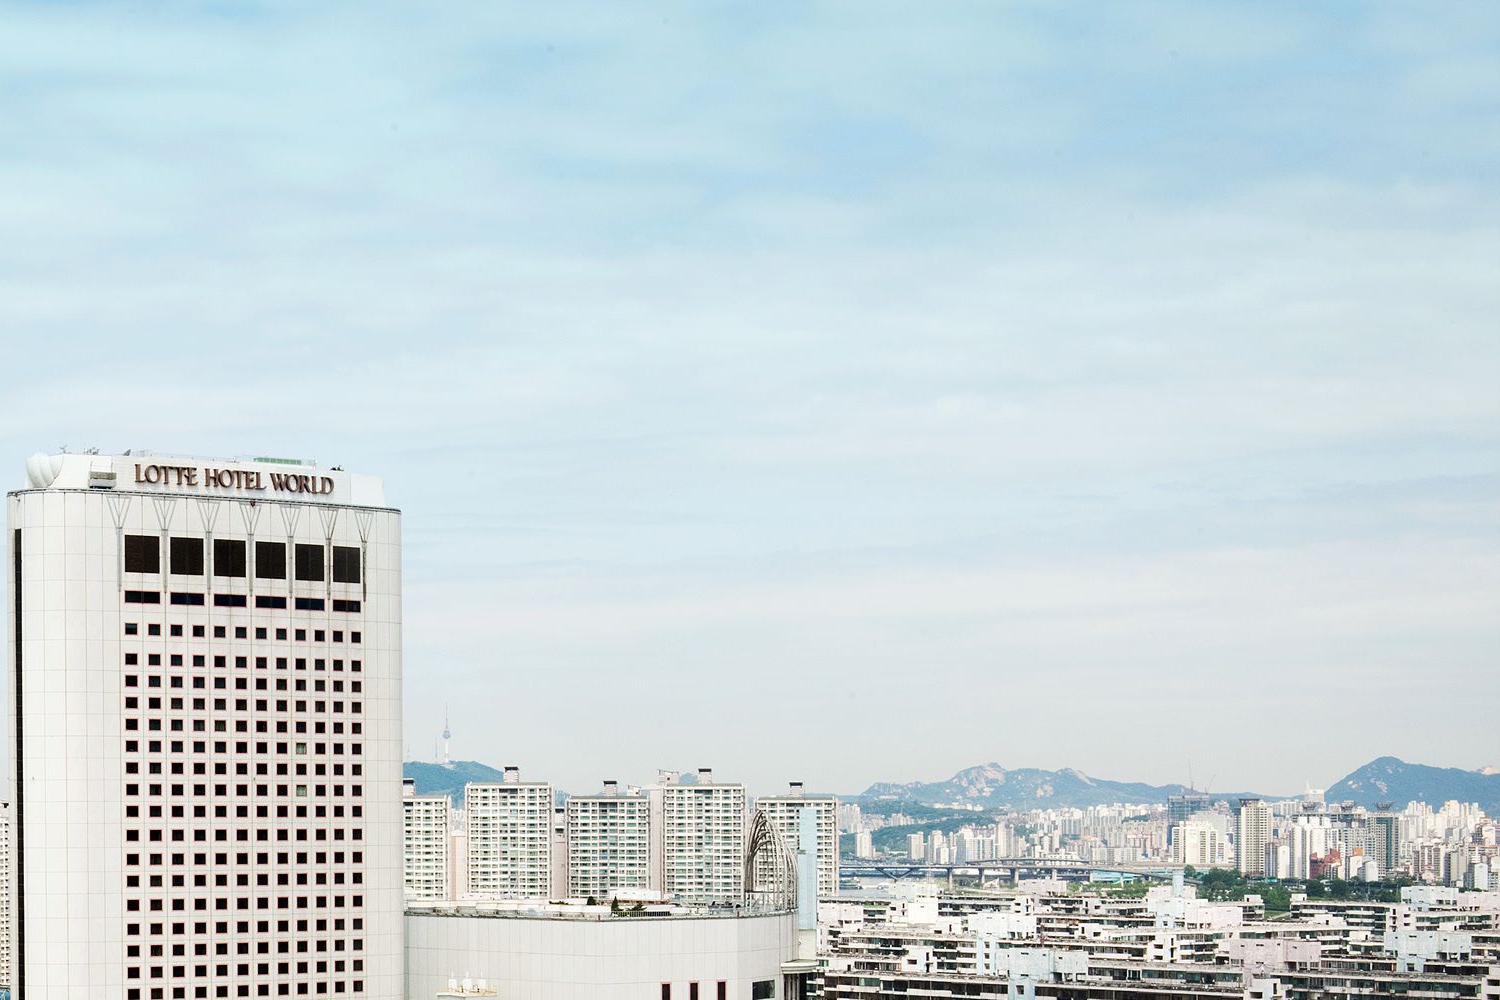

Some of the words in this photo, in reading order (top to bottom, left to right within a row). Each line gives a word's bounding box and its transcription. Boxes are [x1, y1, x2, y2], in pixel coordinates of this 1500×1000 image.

[134, 463, 198, 486] LOTTE
[204, 468, 268, 491] HOTEL
[269, 472, 335, 495] WORLD
